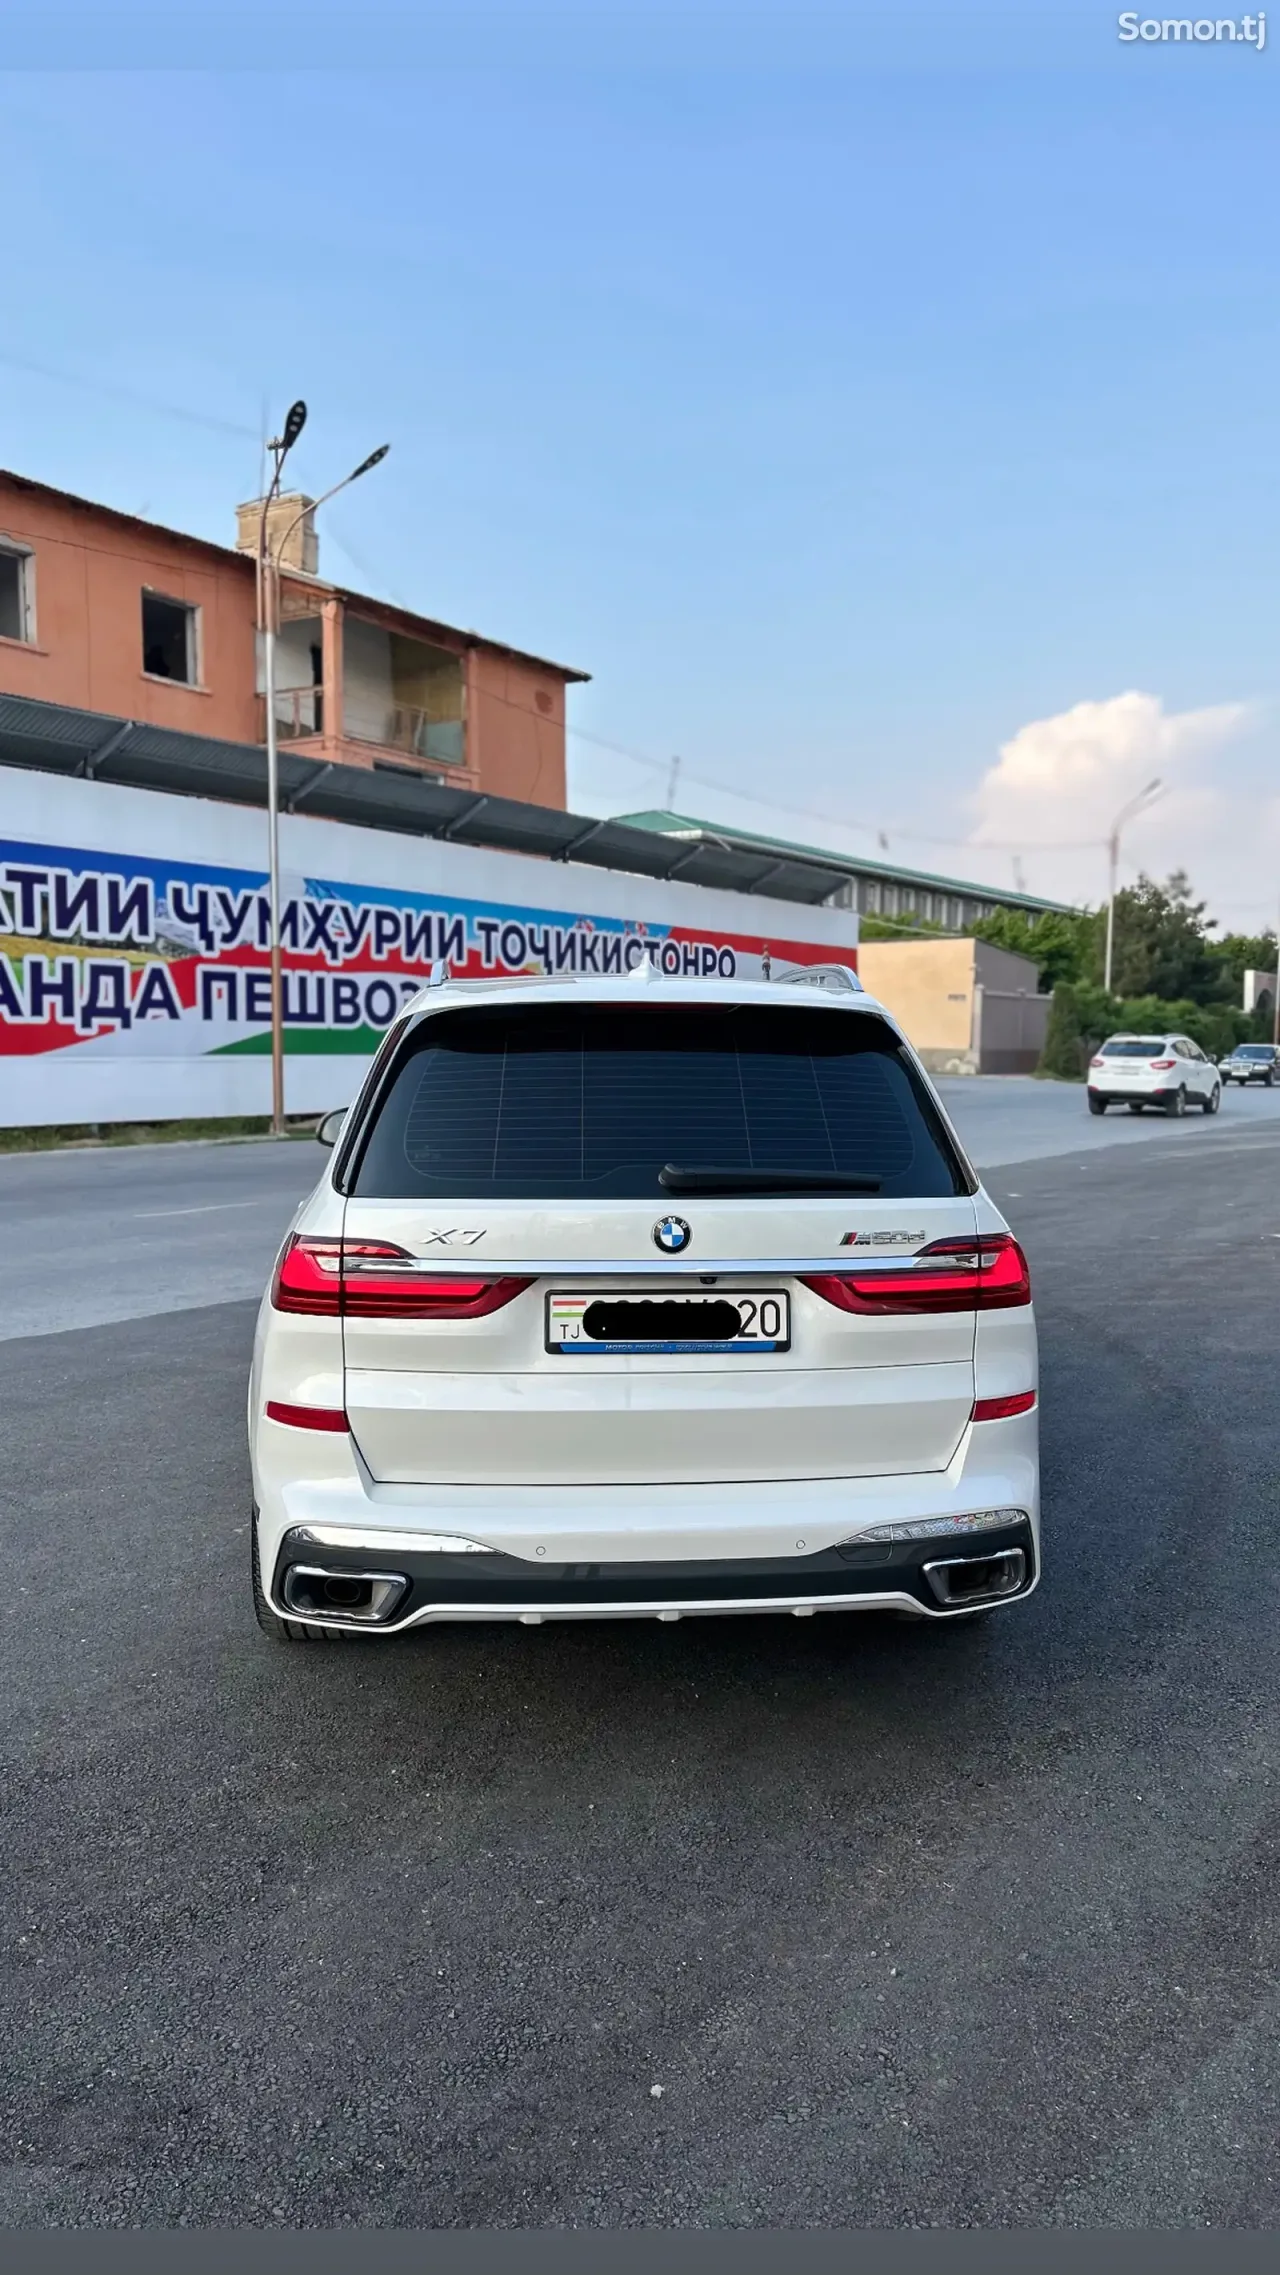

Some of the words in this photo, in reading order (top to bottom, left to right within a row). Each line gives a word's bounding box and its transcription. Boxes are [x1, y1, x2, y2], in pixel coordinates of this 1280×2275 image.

[0, 869, 150, 937] ТИИ
[477, 922, 736, 978] ТОҶИКИСТОНРО
[420, 1227, 487, 1245] X7
[560, 1324, 580, 1339] TJ
